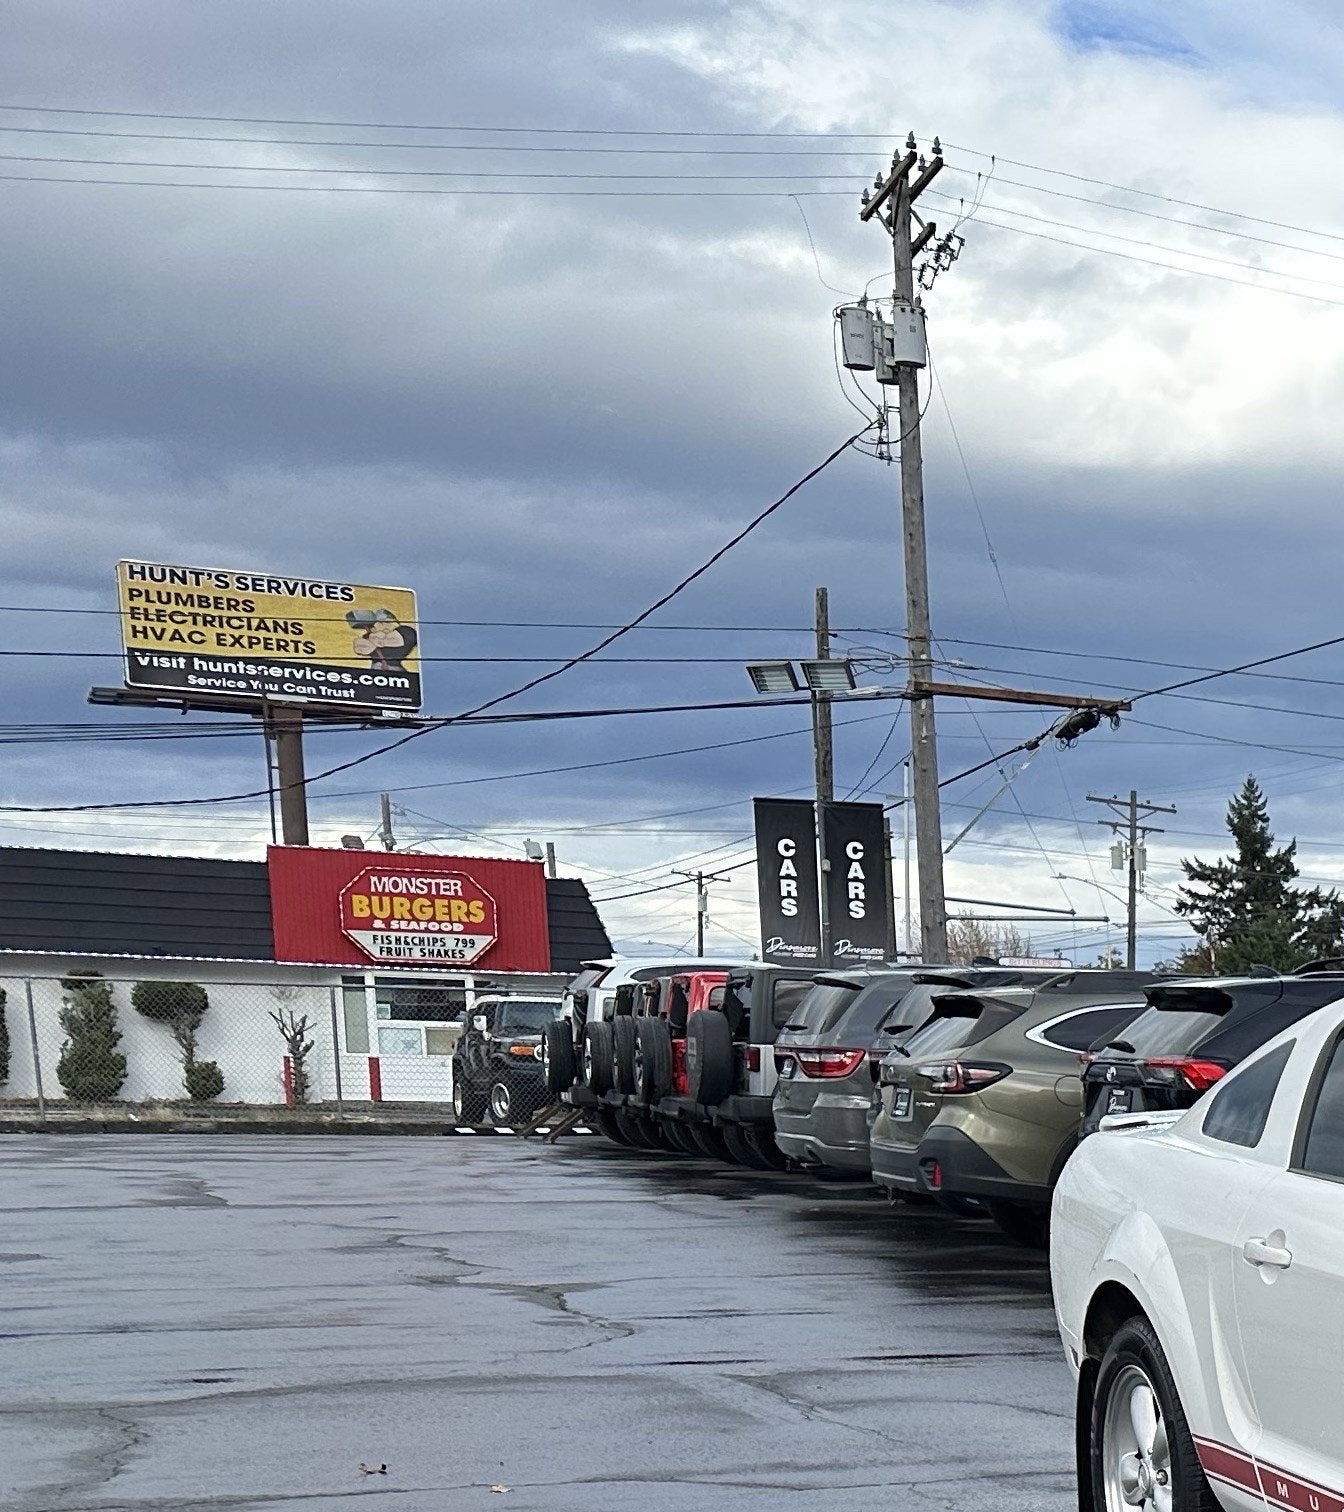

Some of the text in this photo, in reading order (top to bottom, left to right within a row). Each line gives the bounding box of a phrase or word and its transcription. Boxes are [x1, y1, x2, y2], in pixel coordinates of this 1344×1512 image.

[128, 565, 355, 602] HUNT'S SERVICES
[128, 588, 255, 613] PLUMBERS
[130, 607, 304, 636] ELECTRICIANS
[131, 624, 316, 654] HVAC EXPERTS
[187, 674, 247, 689] Service
[282, 682, 317, 695] Can
[318, 686, 356, 698] Trust
[369, 875, 464, 897] MONSTER
[777, 838, 798, 917] CARS
[845, 841, 866, 919] CARS
[351, 894, 486, 923] BURGERS
[372, 919, 465, 932] & SEAFOOD
[379, 946, 466, 959] FRUIT SHAKES
[453, 937, 476, 948] 799
